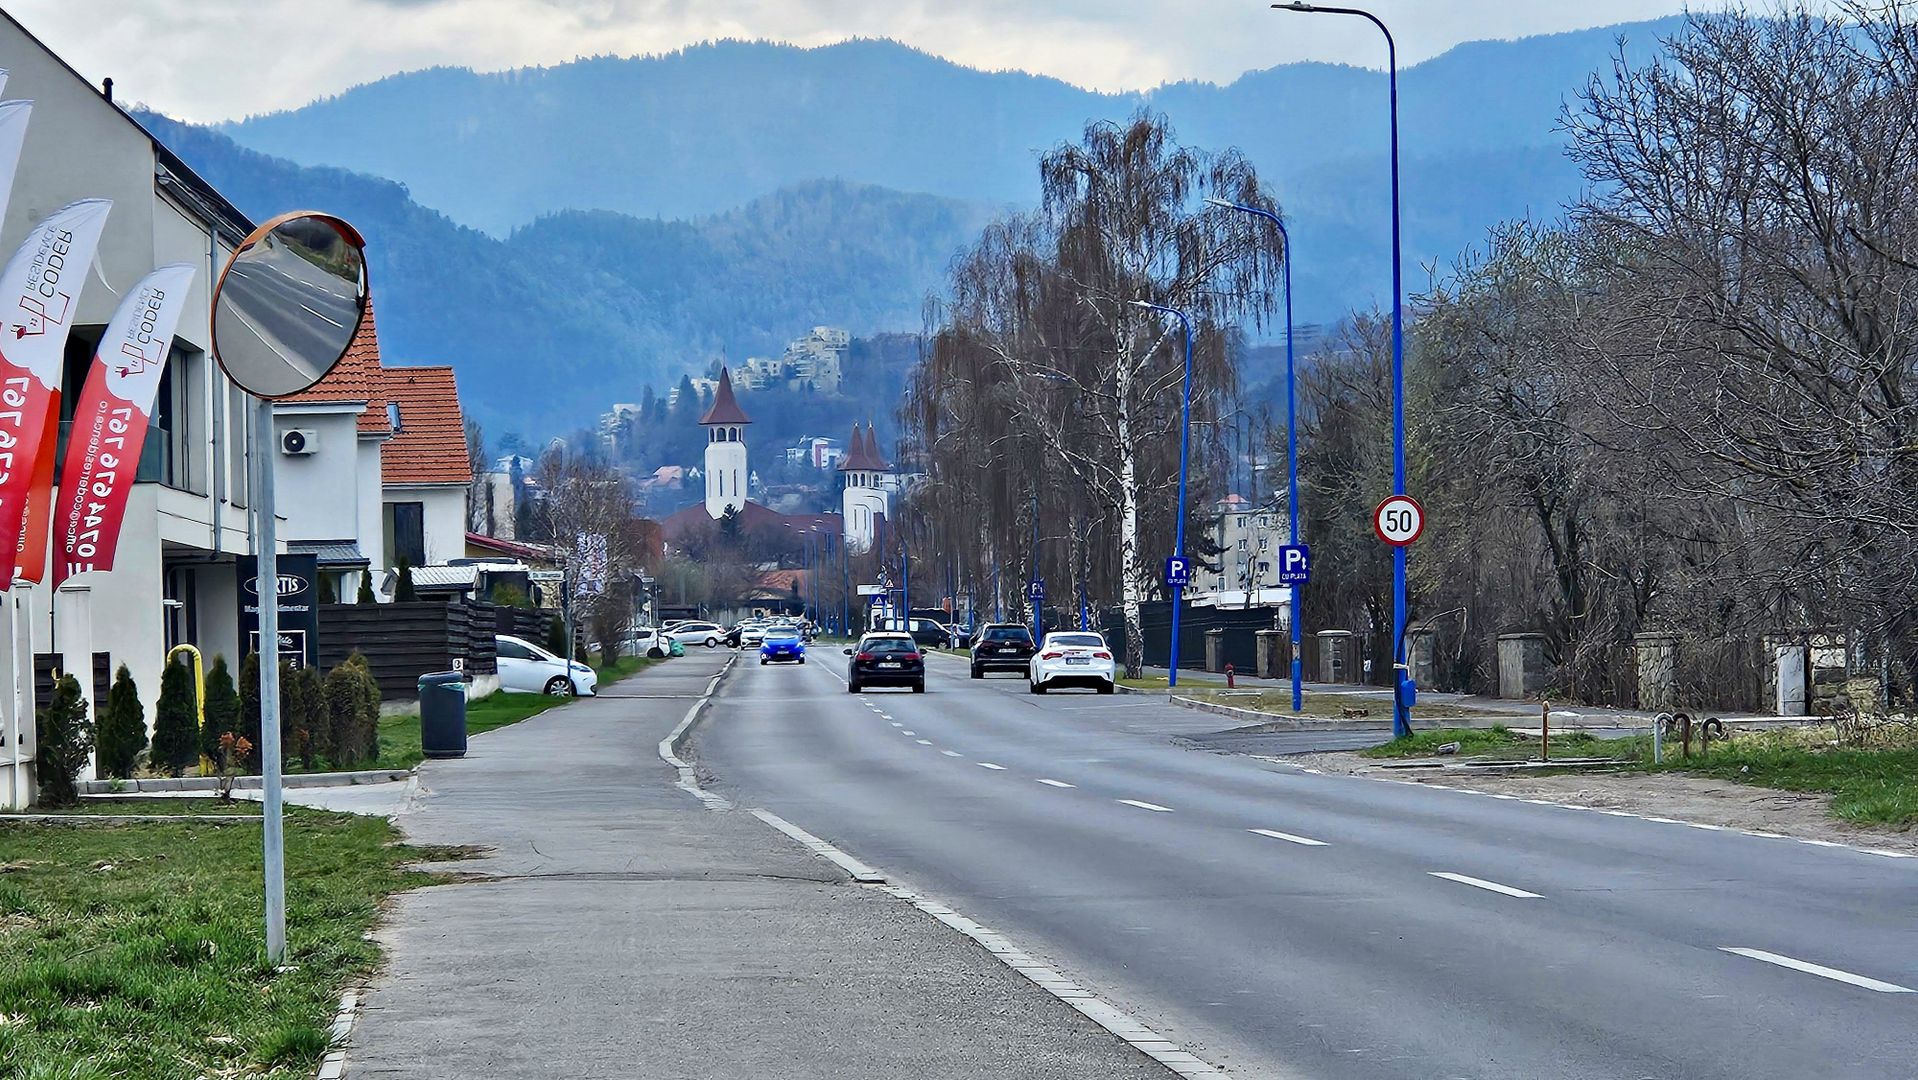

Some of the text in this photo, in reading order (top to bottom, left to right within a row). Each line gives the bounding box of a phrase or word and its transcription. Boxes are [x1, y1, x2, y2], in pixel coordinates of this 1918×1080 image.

[1386, 510, 1412, 533] 50
[1171, 560, 1183, 577] P
[1286, 549, 1301, 571] P
